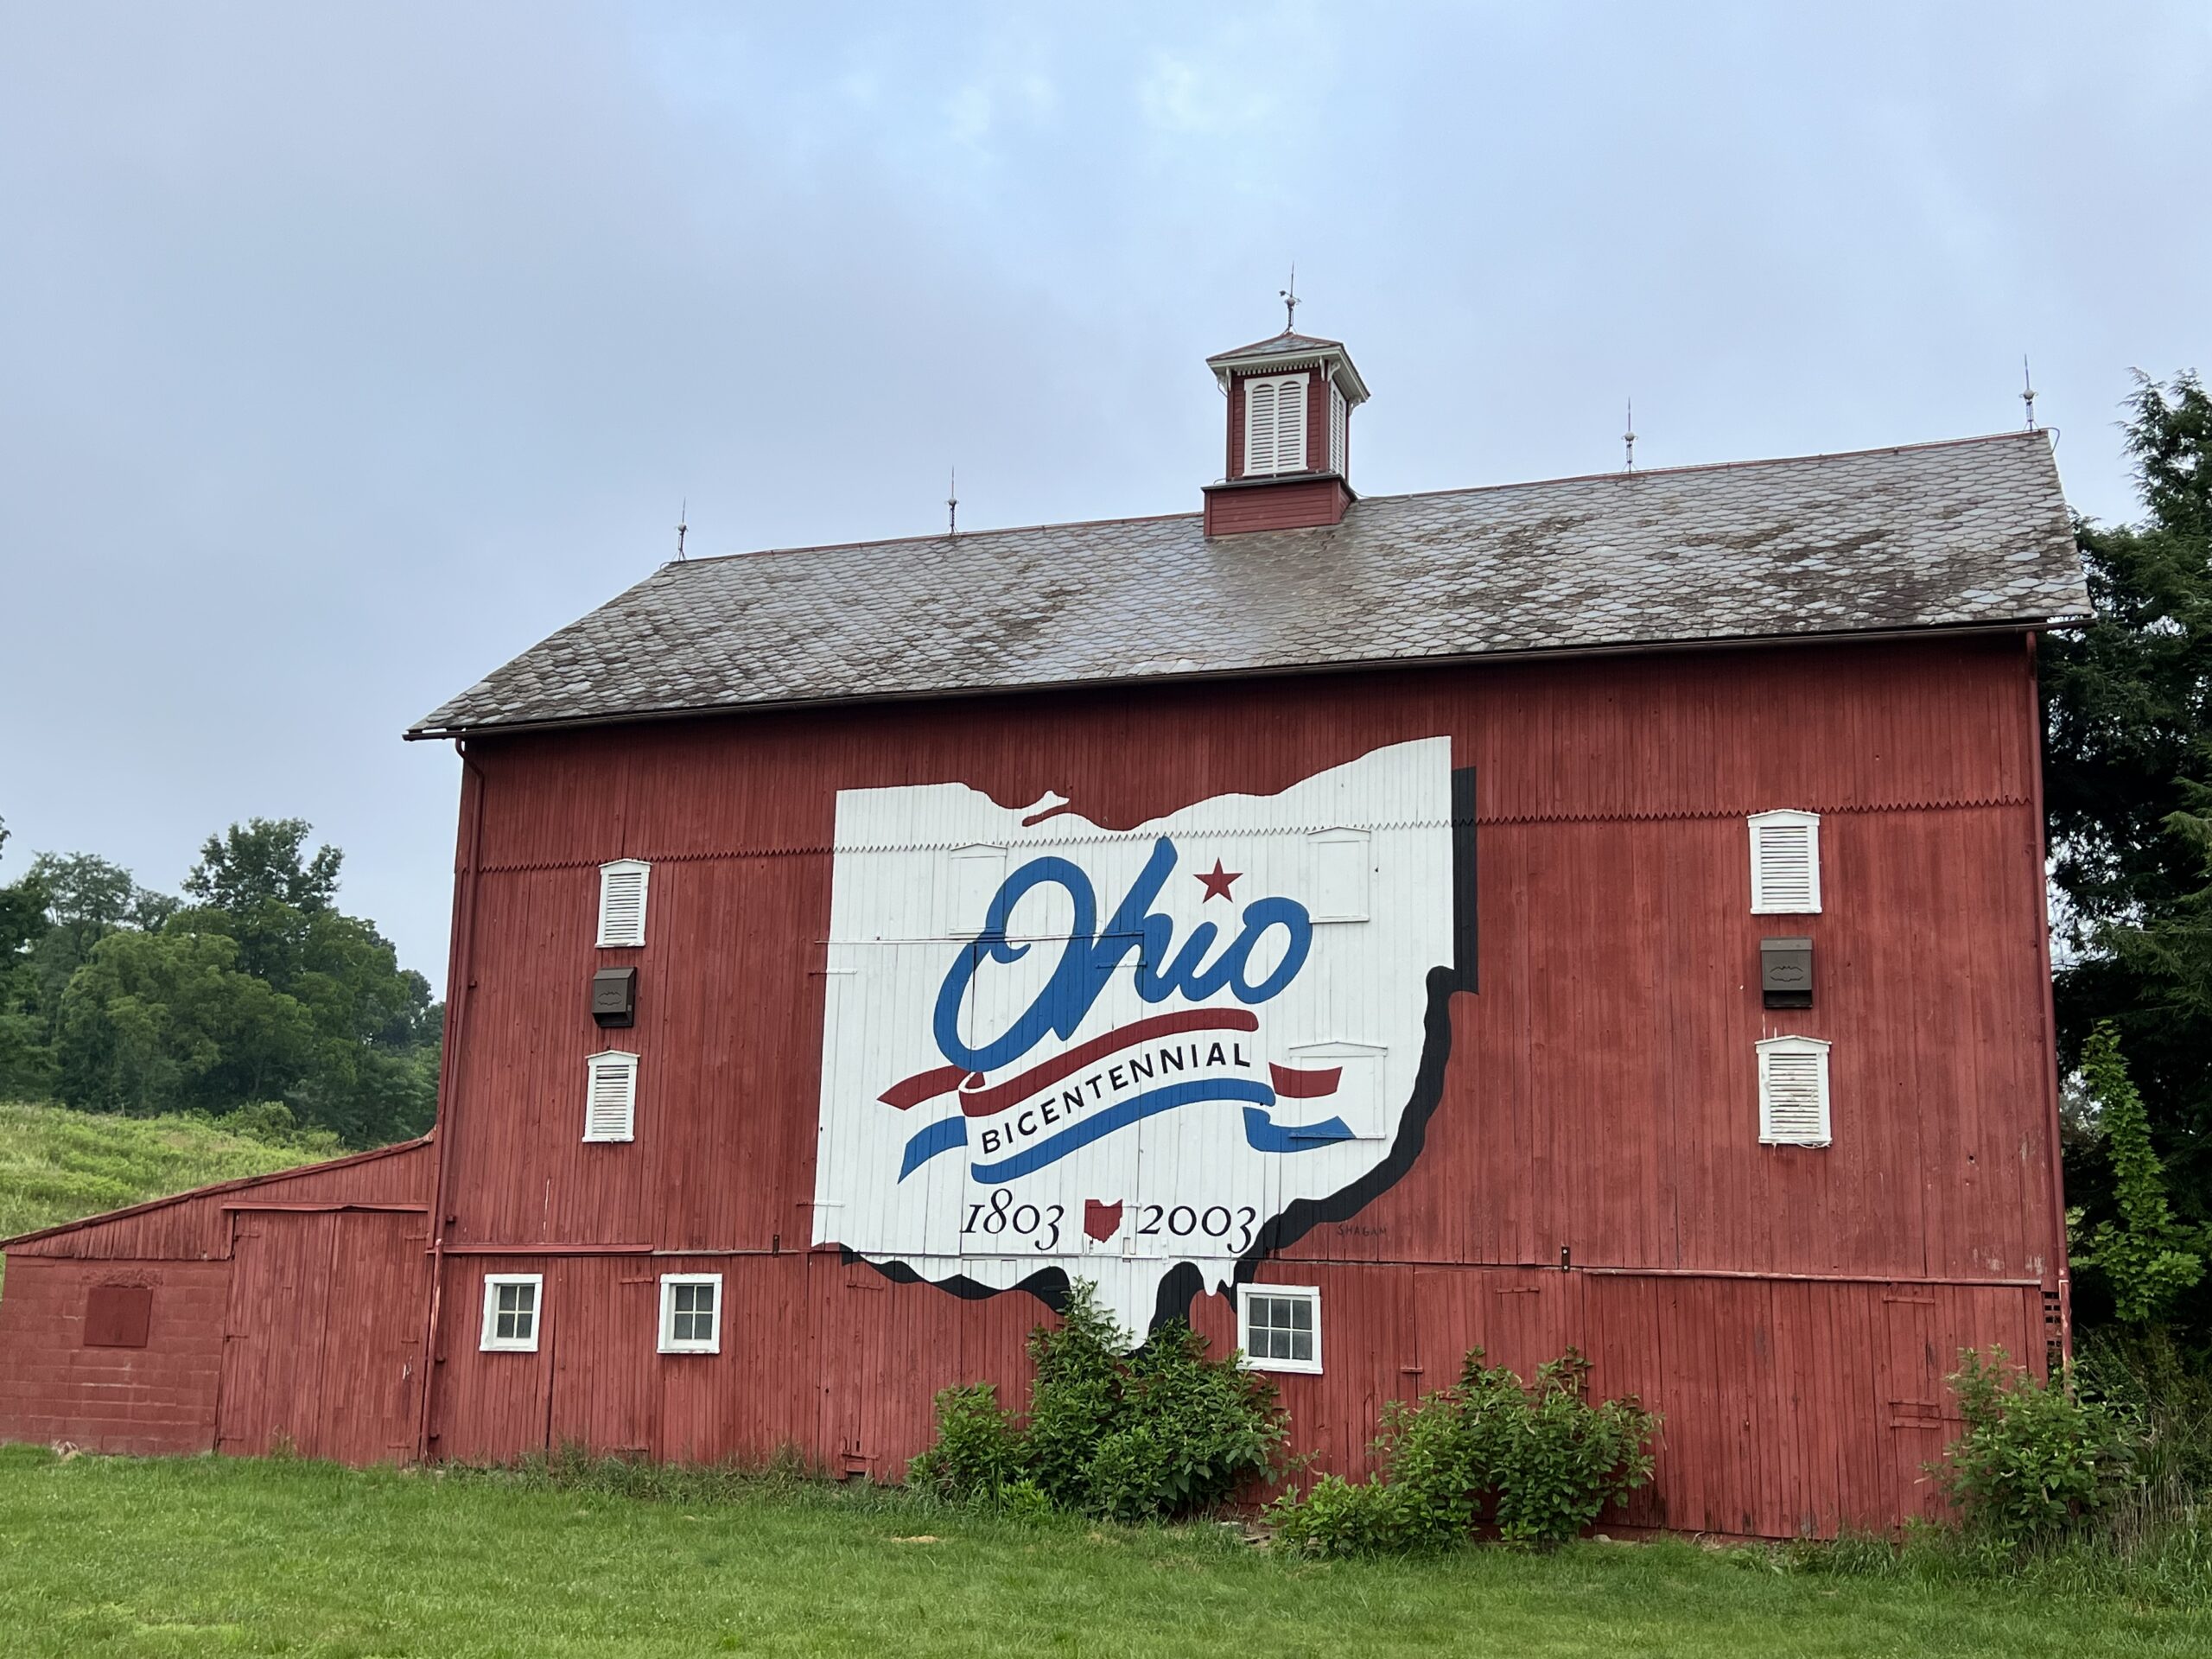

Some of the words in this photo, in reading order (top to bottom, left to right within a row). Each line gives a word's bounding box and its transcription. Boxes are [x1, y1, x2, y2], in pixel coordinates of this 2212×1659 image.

[933, 836, 1313, 1072] Ohio
[982, 1042, 1250, 1154] BICENTENNIAL
[960, 1188, 1065, 1250] 1803
[1137, 1205, 1256, 1254] 2003
